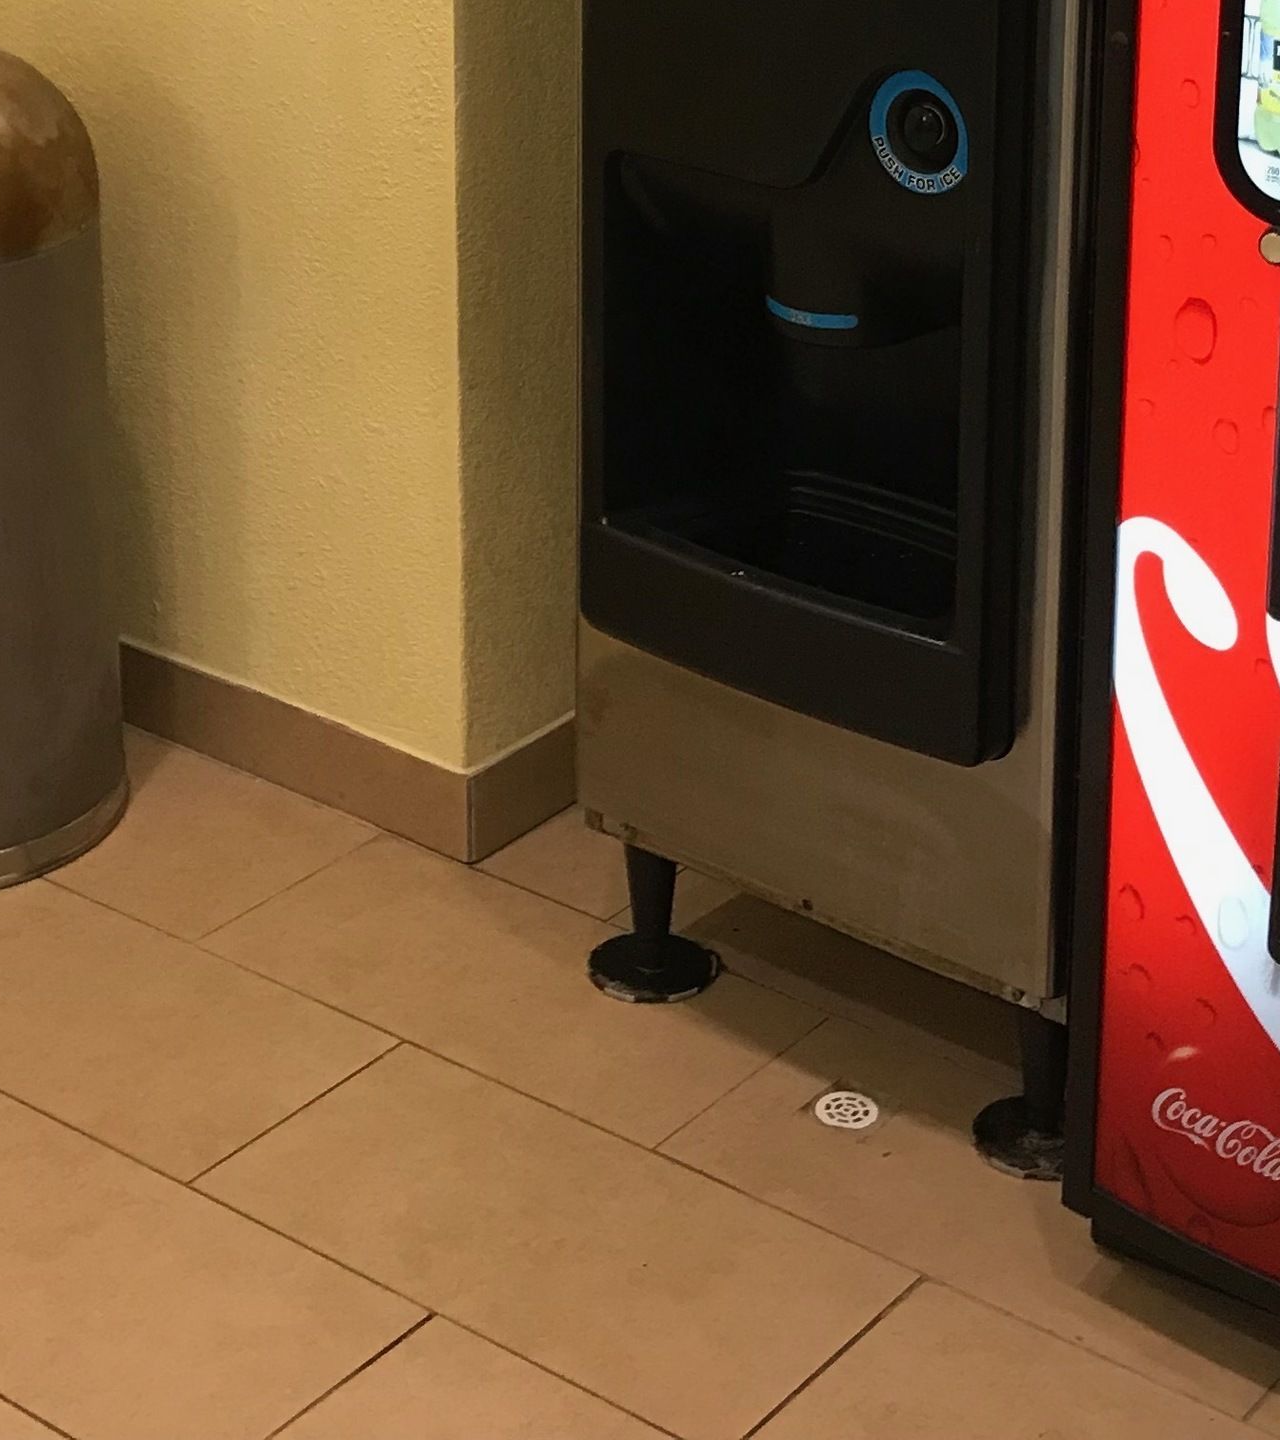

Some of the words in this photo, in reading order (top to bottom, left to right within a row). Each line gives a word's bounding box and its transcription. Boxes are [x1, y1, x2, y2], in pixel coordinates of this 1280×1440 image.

[873, 136, 905, 179] PUSH
[907, 175, 936, 190] FOR
[940, 166, 961, 188] ICE
